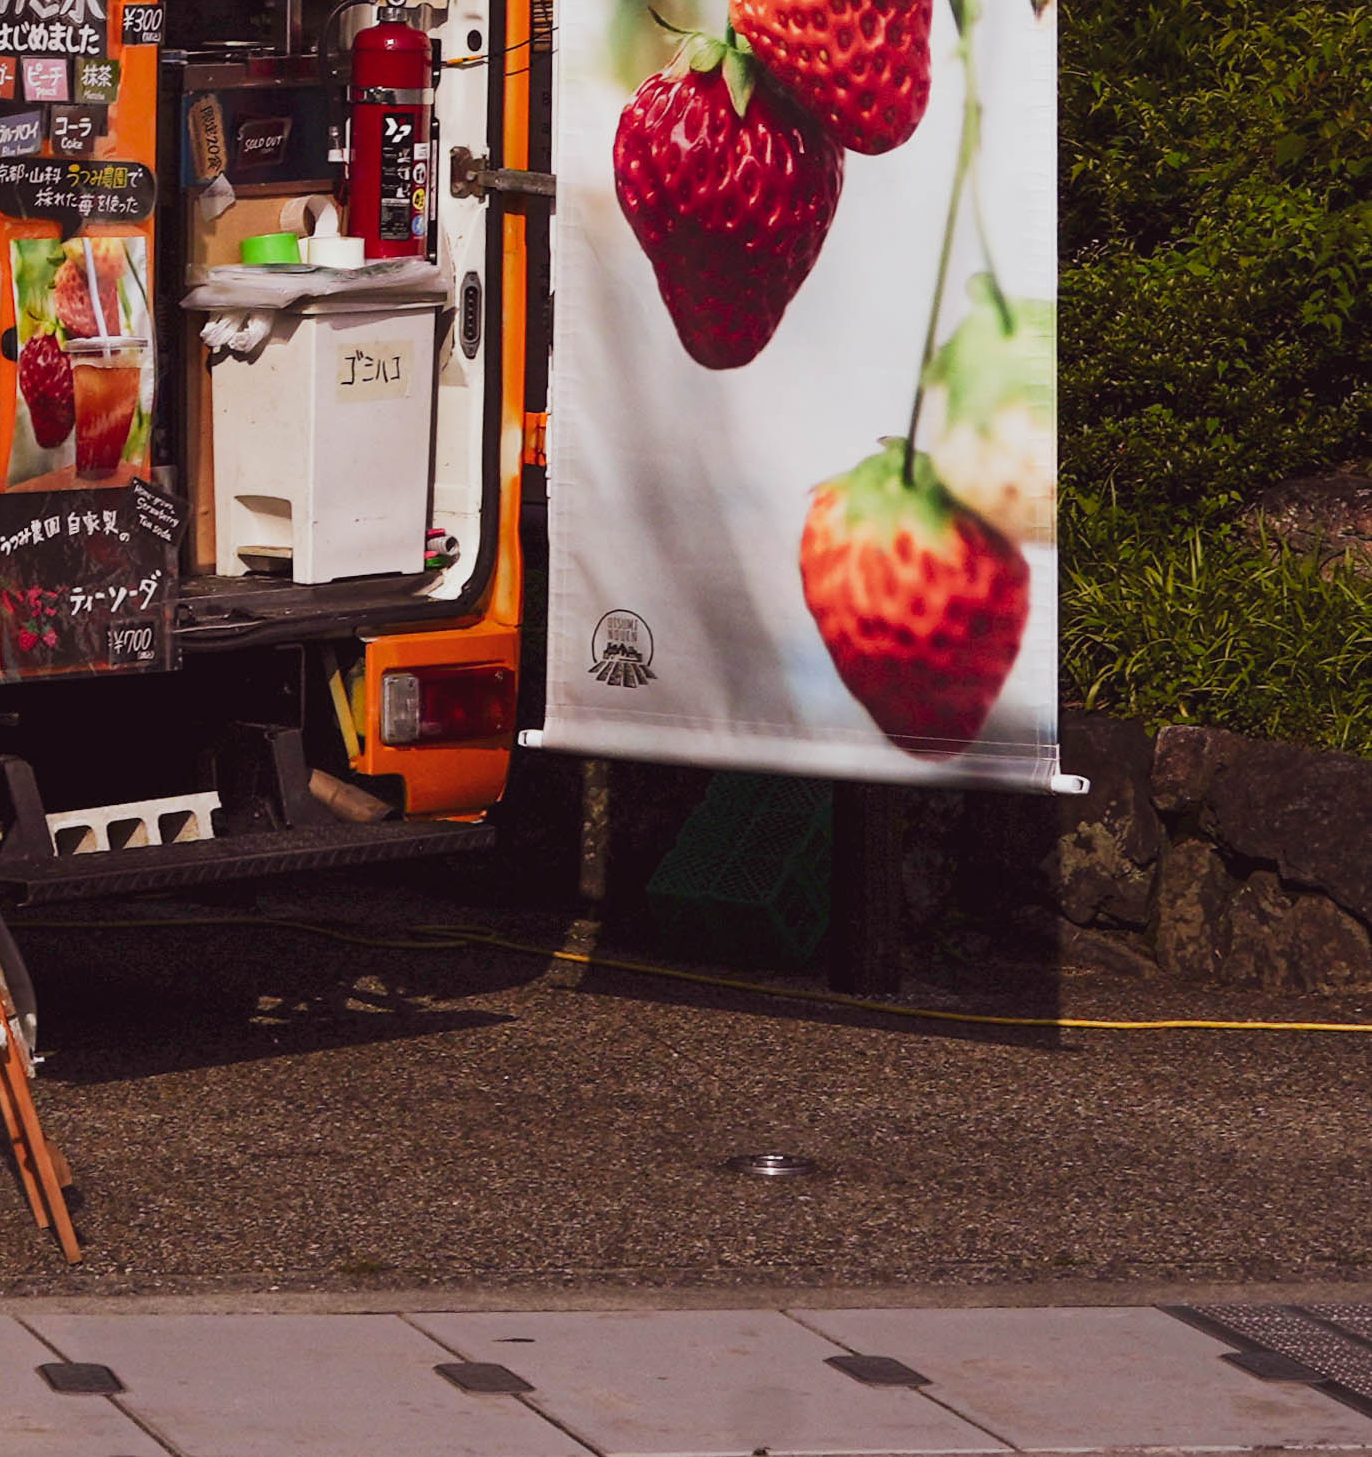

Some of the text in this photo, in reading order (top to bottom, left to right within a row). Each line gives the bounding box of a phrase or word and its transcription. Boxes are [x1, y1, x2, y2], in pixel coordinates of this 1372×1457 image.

[123, 7, 163, 34] ¥300
[27, 62, 64, 86] ピーチ
[81, 63, 114, 88] 抹茶
[55, 116, 93, 136] コーラ
[66, 164, 144, 189] うつみ農園で
[340, 350, 403, 386] ゴミハコ
[0, 509, 131, 556] うつみ農園 自家製の
[69, 569, 162, 616] ティーソーダ
[113, 627, 153, 654] ¥700
